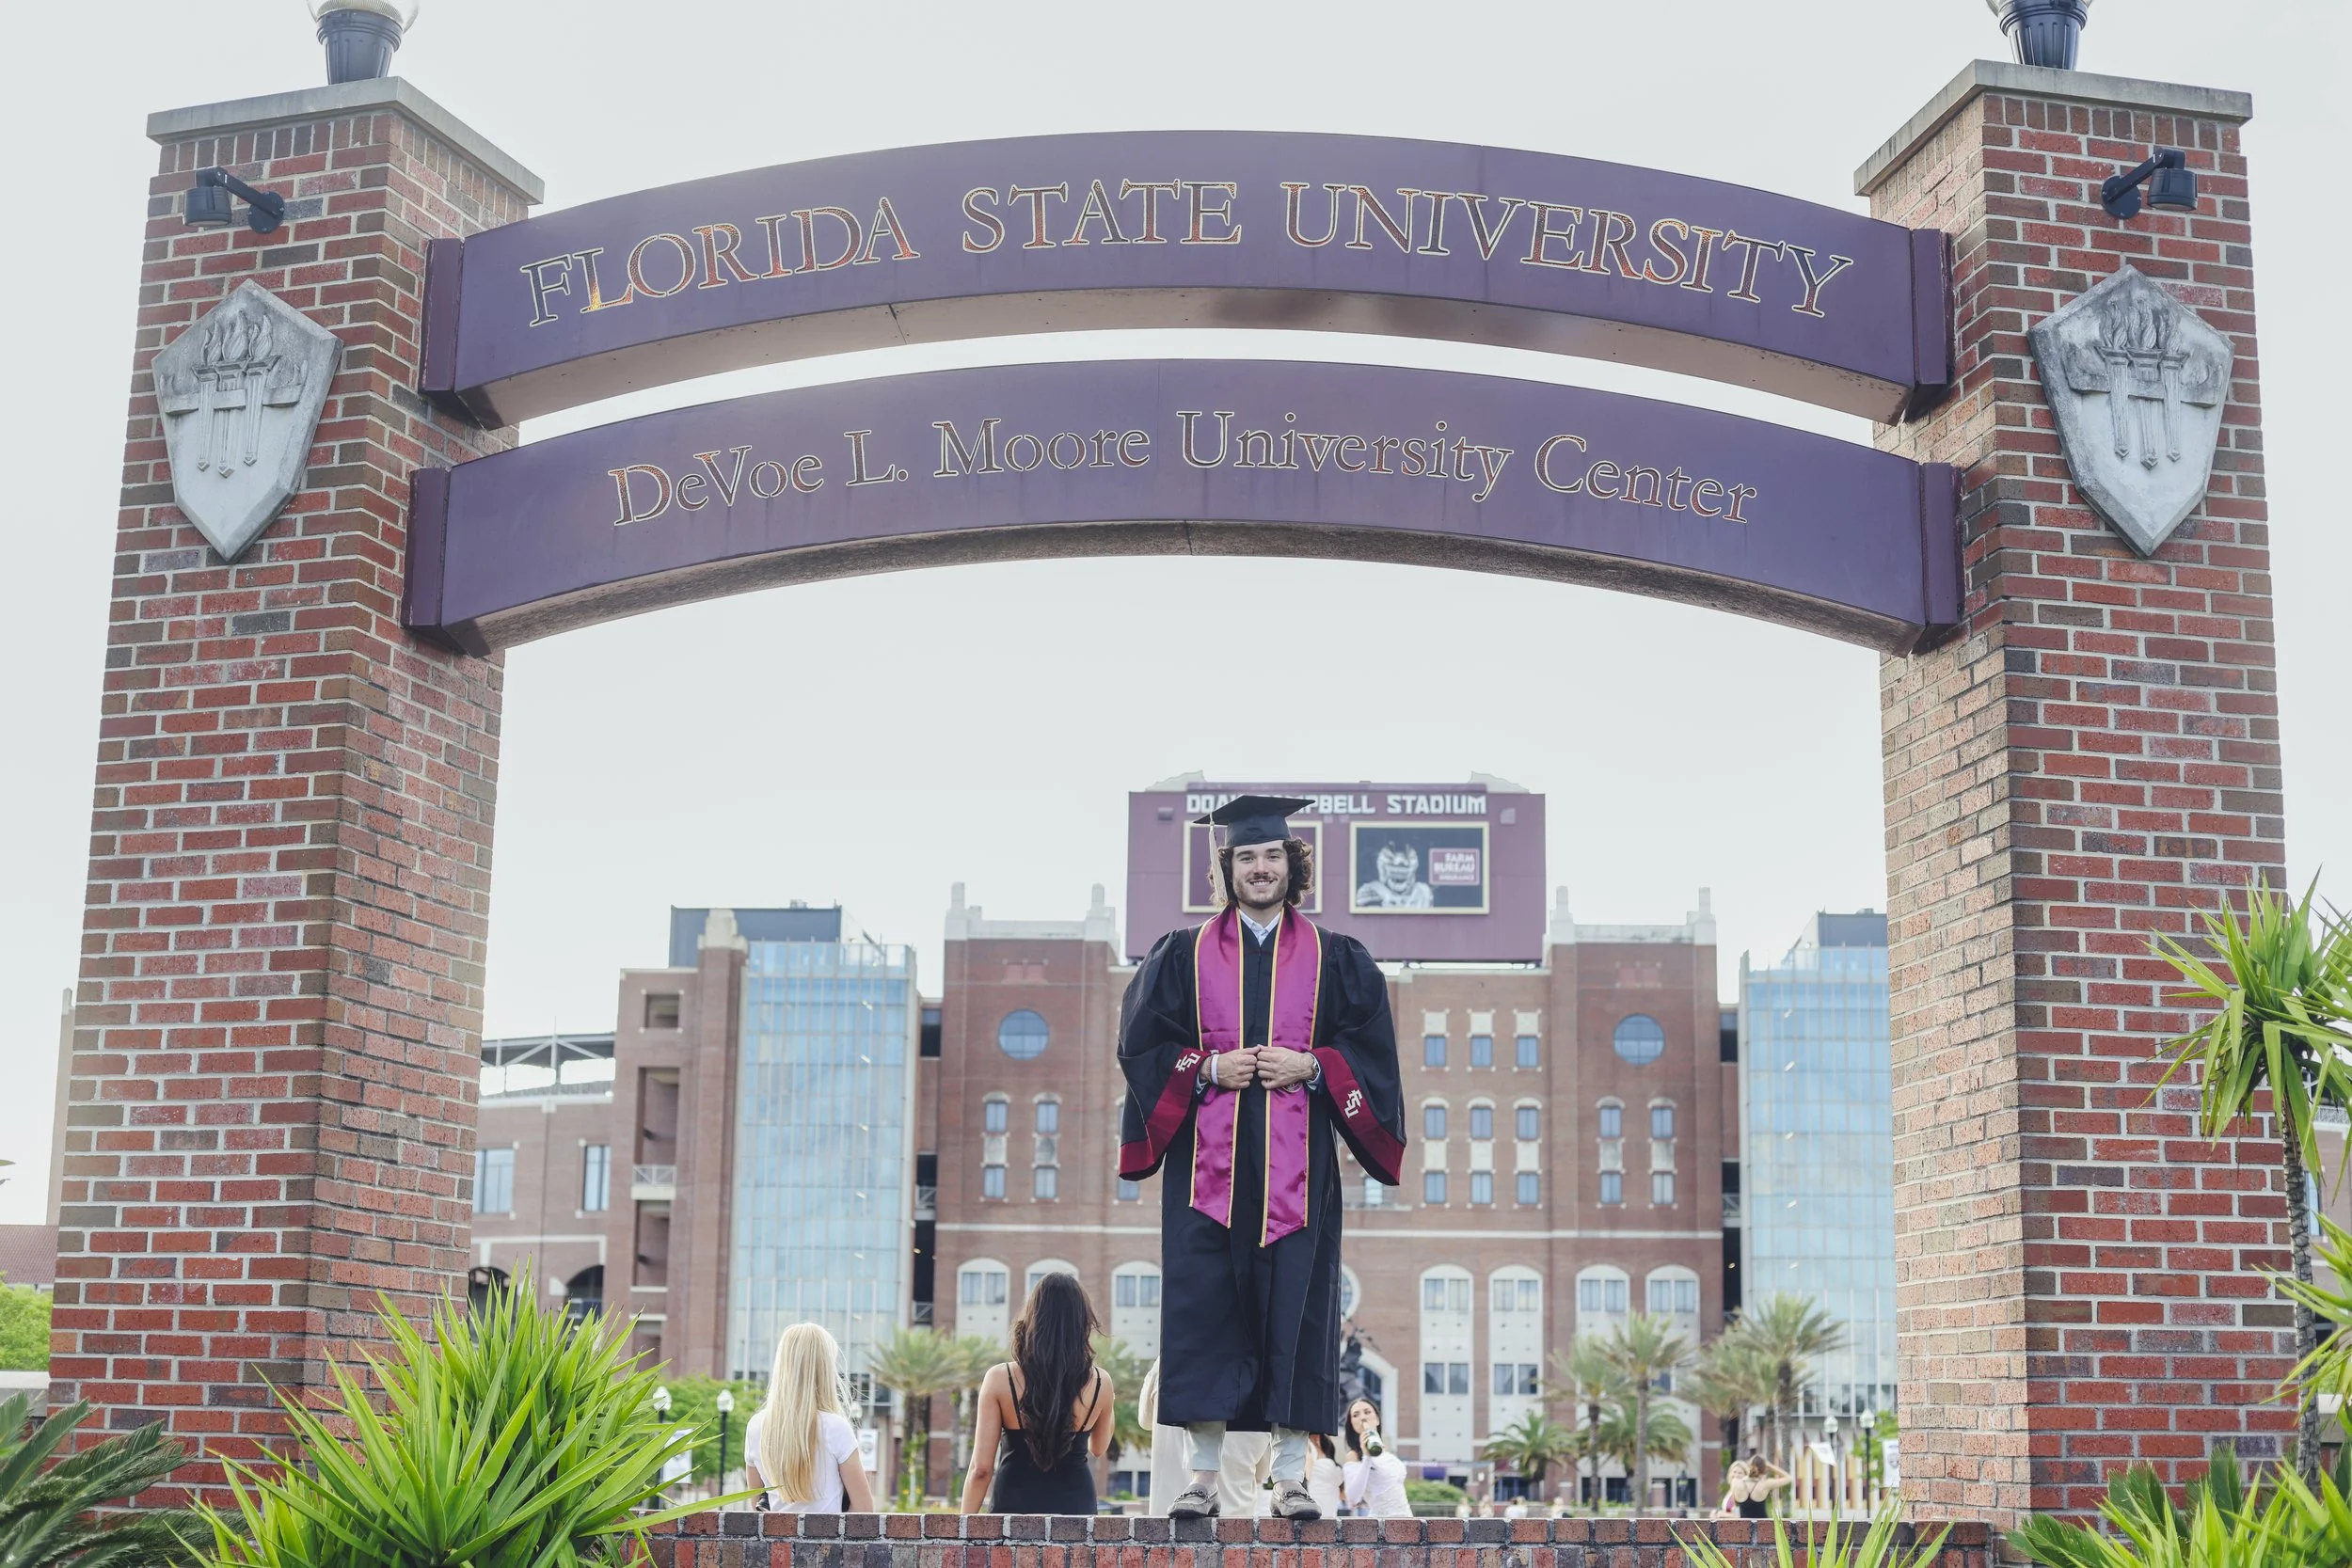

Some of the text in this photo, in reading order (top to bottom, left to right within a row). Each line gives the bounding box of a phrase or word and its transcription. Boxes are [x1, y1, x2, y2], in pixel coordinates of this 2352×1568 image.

[519, 179, 1855, 328] FLORIDA STATE UNIVERSITY
[607, 410, 1757, 527] DeVoe L. Moore University Center
[1185, 794, 1487, 815] DOA PBELL STADIUM
[1175, 1053, 1201, 1072] FSU
[1343, 1089, 1363, 1119] FSU
